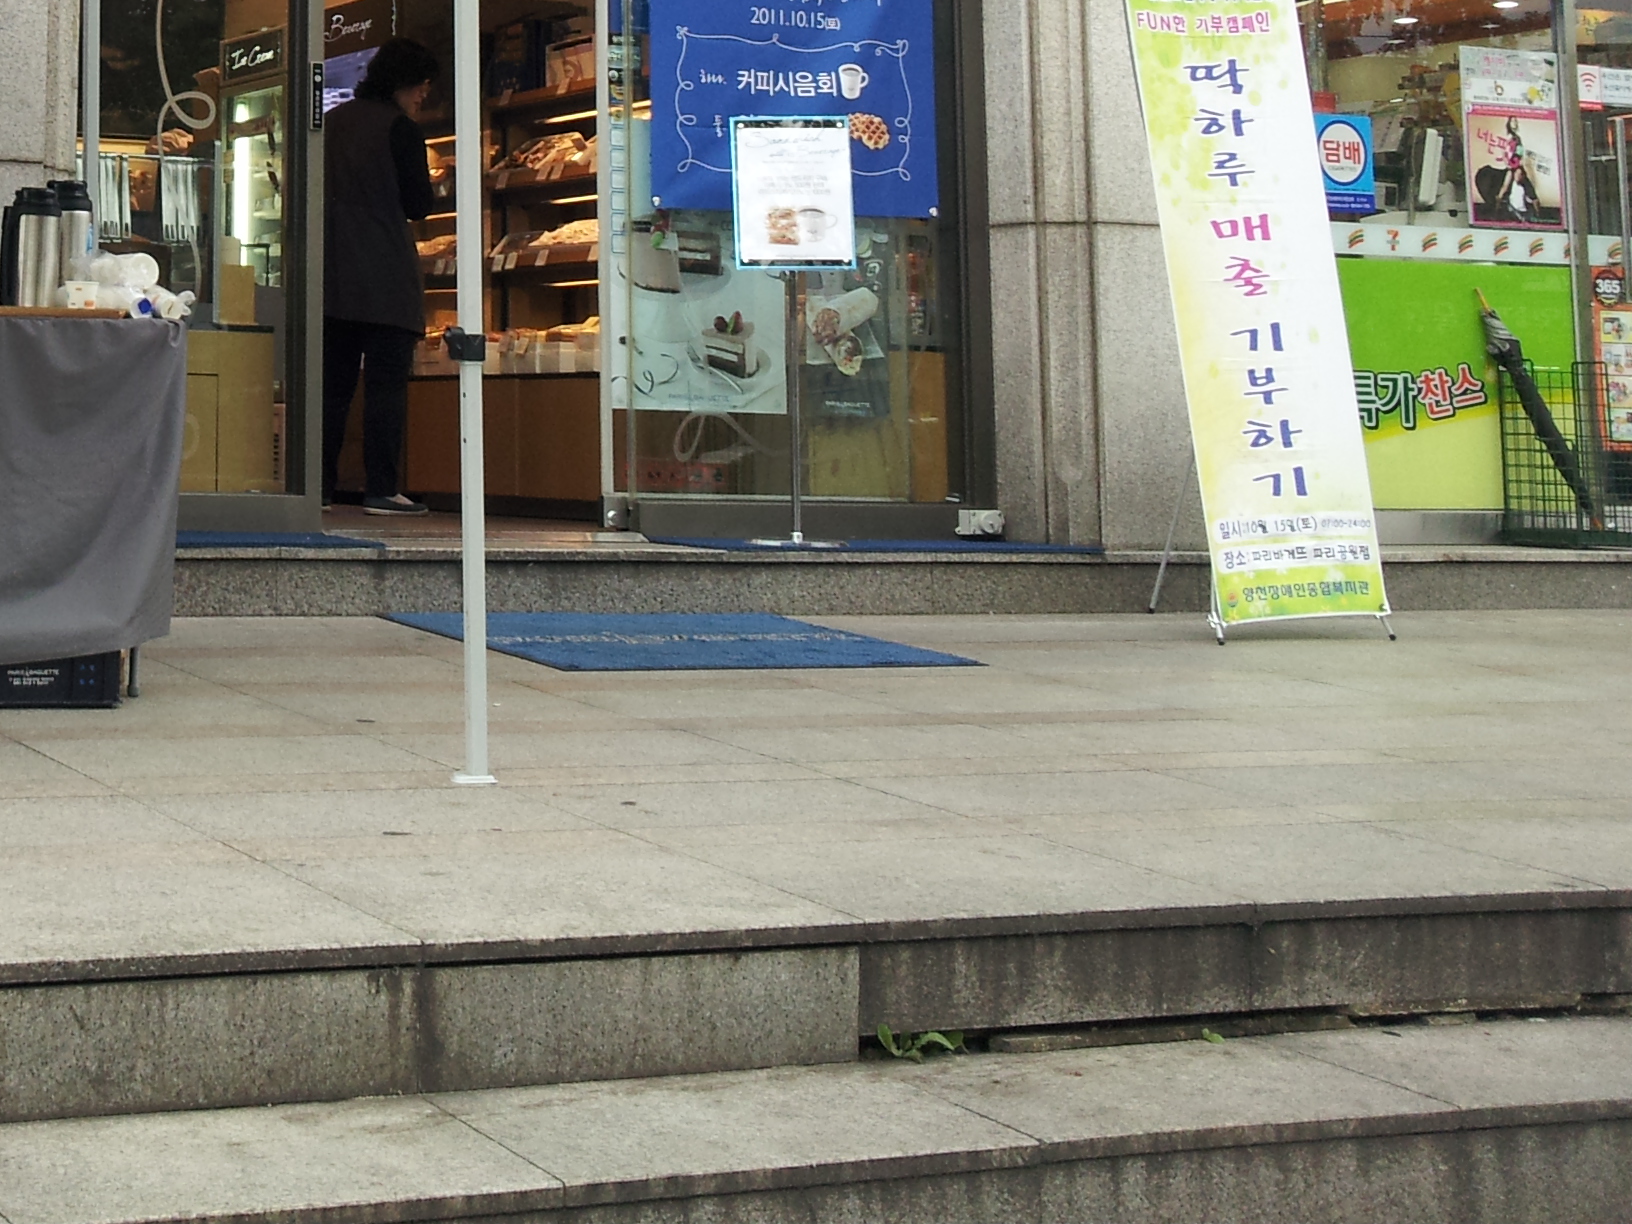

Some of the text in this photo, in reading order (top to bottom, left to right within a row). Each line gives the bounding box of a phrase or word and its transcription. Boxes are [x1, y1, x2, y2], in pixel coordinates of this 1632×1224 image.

[1136, 11, 1270, 33] FUN한 기부캠페인
[737, 68, 838, 97] 커피시음회
[1322, 140, 1361, 165] 담배
[1595, 279, 1621, 294] 365
[1353, 363, 1485, 429] 특가찬스
[1253, 546, 1307, 561] 파리바게뜨
